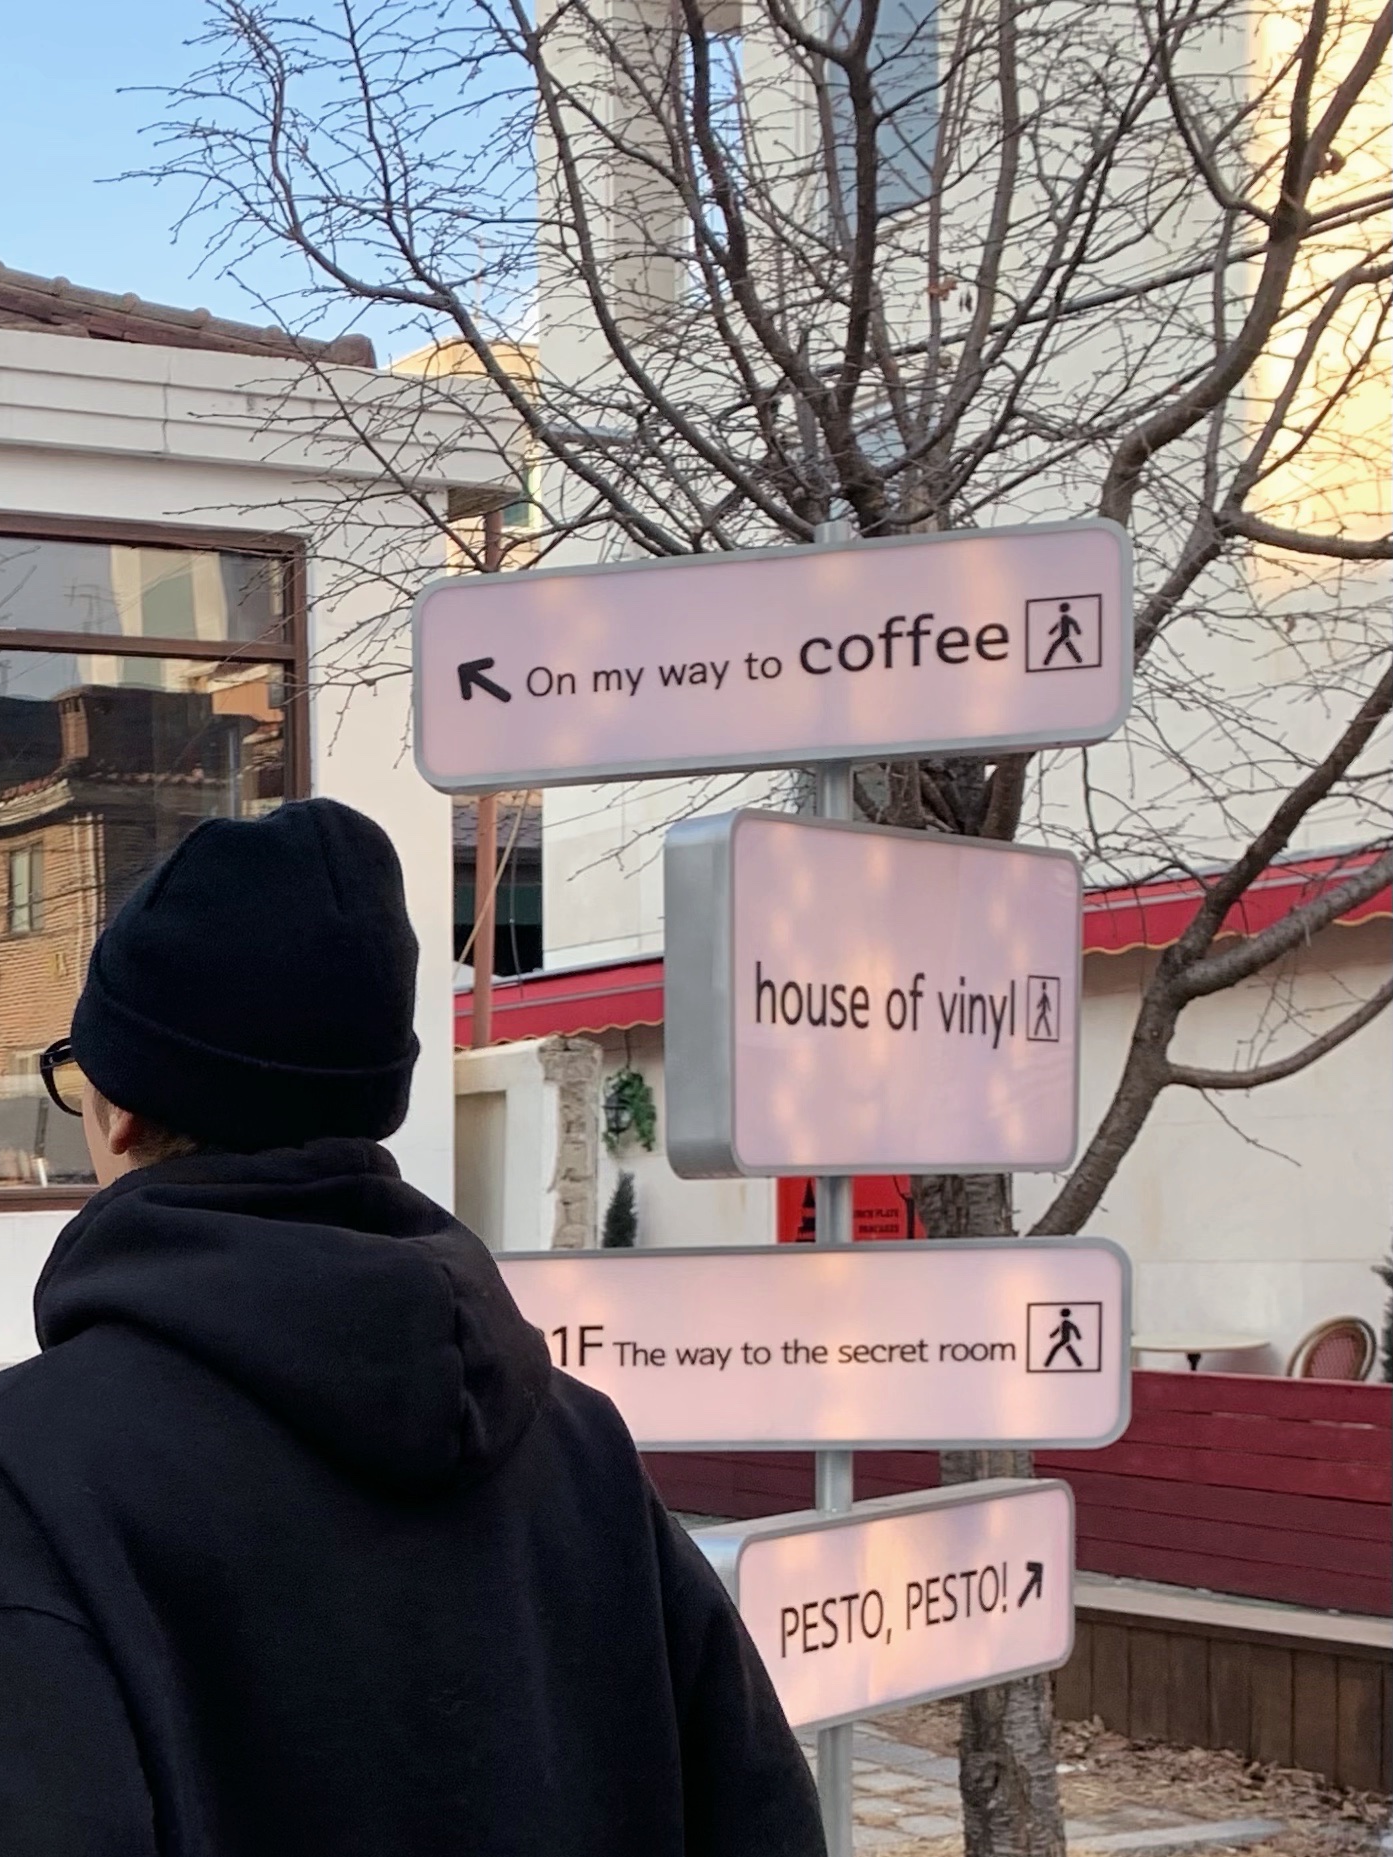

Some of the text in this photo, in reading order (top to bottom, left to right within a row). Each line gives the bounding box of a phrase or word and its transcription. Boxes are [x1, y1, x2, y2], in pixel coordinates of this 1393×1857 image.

[525, 612, 1010, 698] On my way to coffee
[755, 960, 1016, 1050] house of vinyl
[612, 1341, 667, 1368] The
[675, 1347, 733, 1372] way
[740, 1341, 772, 1366] to
[781, 1338, 829, 1365] the
[838, 1338, 929, 1364] secret
[938, 1338, 1016, 1363] room
[780, 1561, 1008, 1659] PESTO, PESTO!
